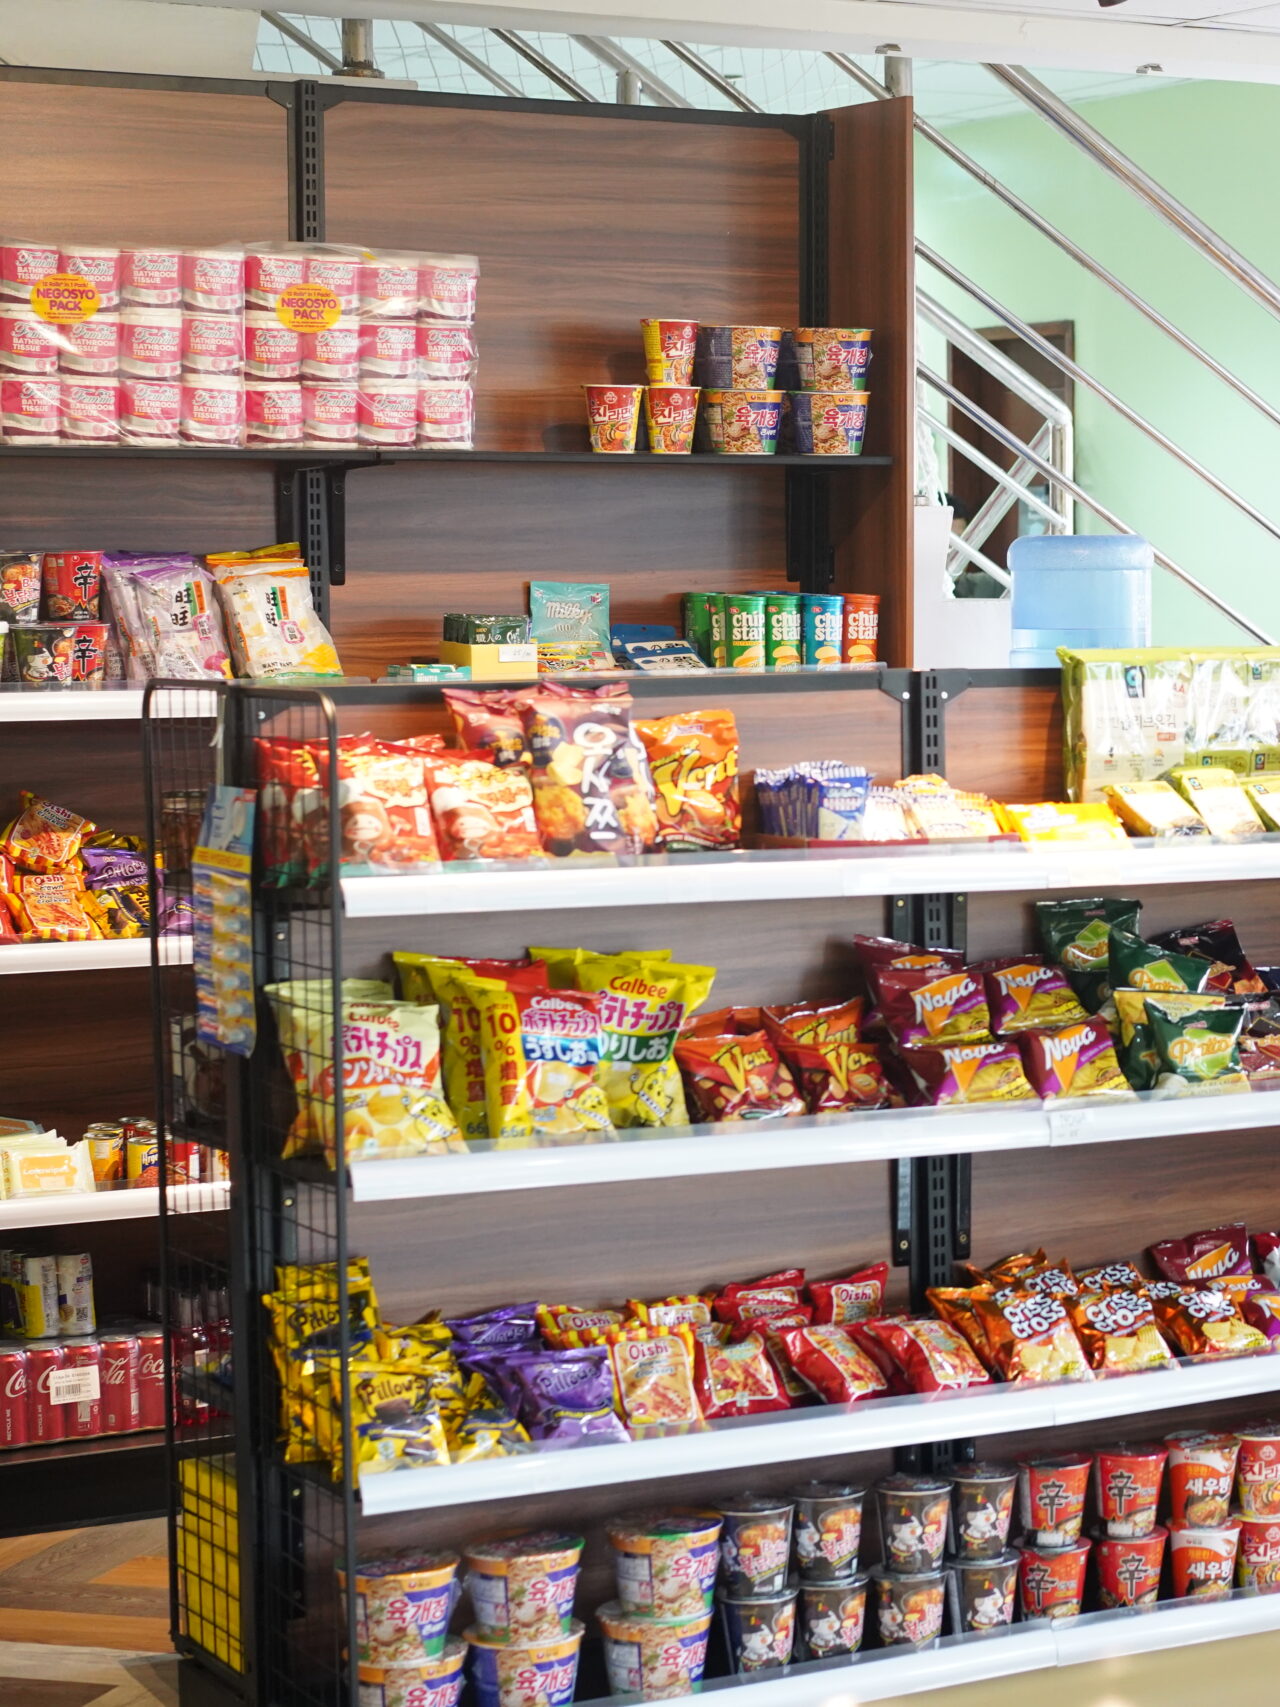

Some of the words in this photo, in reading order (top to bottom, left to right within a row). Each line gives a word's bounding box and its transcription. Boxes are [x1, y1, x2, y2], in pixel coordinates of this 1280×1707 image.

[133, 270, 177, 278] BATHROOM
[195, 275, 237, 284] BATHROOM
[36, 288, 95, 300] NEGOSYO
[281, 297, 337, 309] NEGOSYO
[49, 300, 82, 311] PACK
[293, 309, 325, 320] PACK
[133, 343, 177, 352] BATHROOM
[190, 338, 234, 346] BATHROOM
[826, 345, 868, 365] 육개장
[135, 400, 177, 408] BATHROOM
[193, 406, 236, 414] BATHROOM
[591, 404, 633, 424] 진라면
[735, 406, 779, 427] 육개장
[823, 408, 864, 428] 육개장
[74, 562, 98, 601] 辛
[74, 635, 98, 674] 辛
[610, 975, 668, 999] Calbee
[998, 967, 1055, 995] Nova
[530, 996, 583, 1011] Calbee
[914, 976, 977, 1024] Nova
[522, 1008, 600, 1035] ポテトチップス
[1043, 1025, 1096, 1069] Nova
[943, 1043, 1005, 1072] Nova
[840, 1287, 872, 1301] Oishi
[572, 1315, 610, 1329] Oishi
[629, 1340, 669, 1360] Oishi
[539, 1366, 598, 1393] Pillows
[366, 1377, 425, 1403] Pillows
[1107, 1472, 1140, 1516] 辛
[1185, 1477, 1231, 1496] 새우탕
[1038, 1480, 1069, 1526] 辛
[1116, 1554, 1148, 1598] 辛
[1187, 1561, 1232, 1580] 새우탕
[1027, 1563, 1057, 1609] 辛
[386, 1597, 448, 1624] 육개장
[516, 1665, 573, 1693] 육개장
